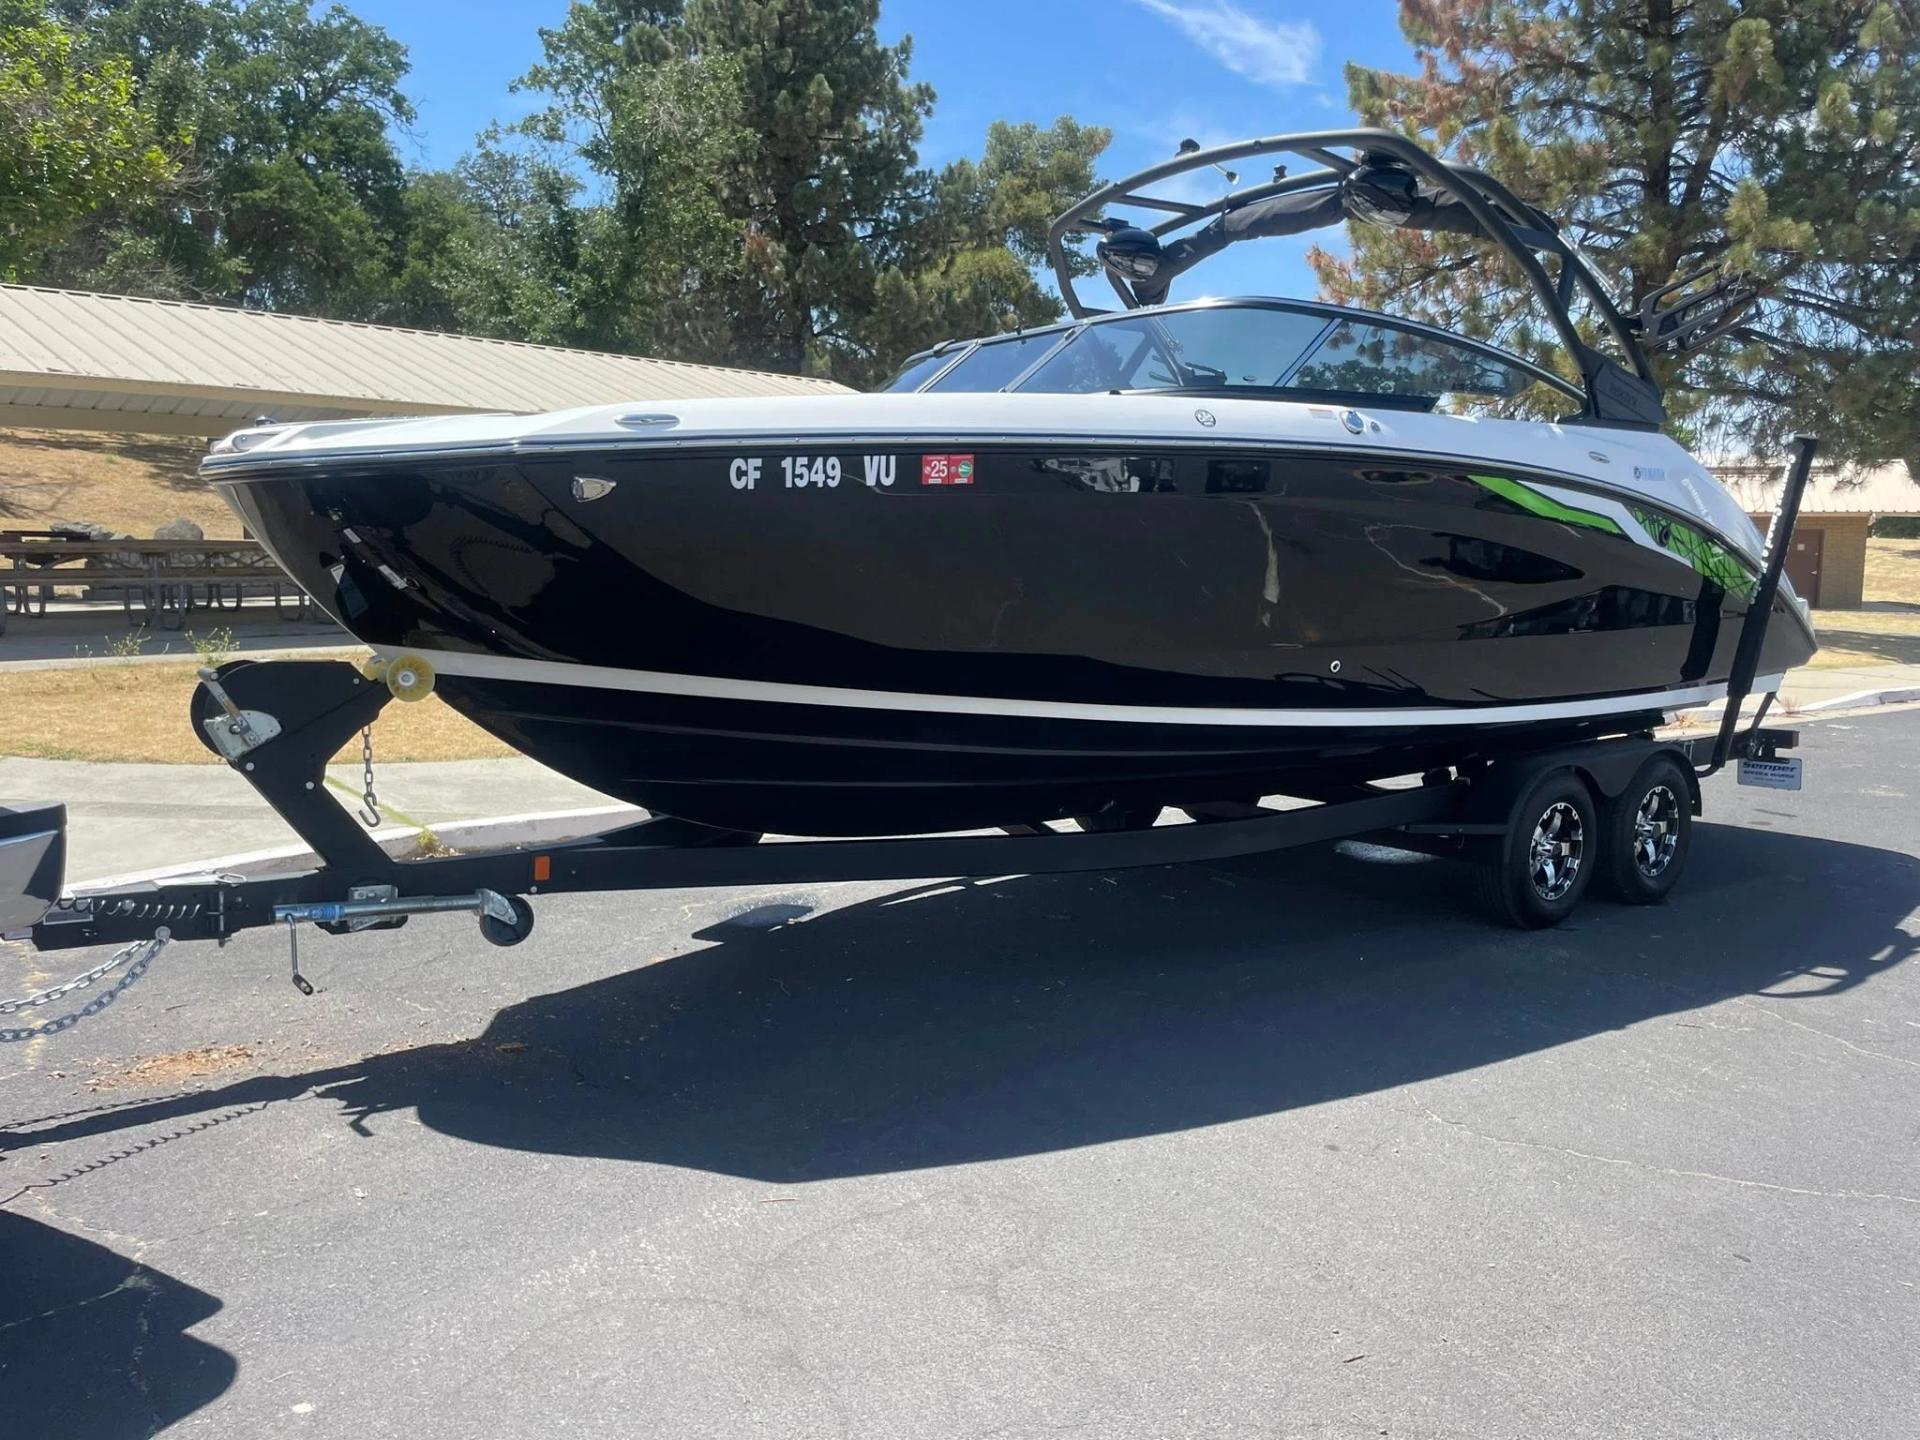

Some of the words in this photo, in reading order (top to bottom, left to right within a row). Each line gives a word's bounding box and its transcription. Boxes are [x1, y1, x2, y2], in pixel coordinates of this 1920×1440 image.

[729, 457, 762, 490] CF
[781, 456, 841, 488] 1549
[864, 455, 896, 487] VU
[930, 460, 948, 477] 25
